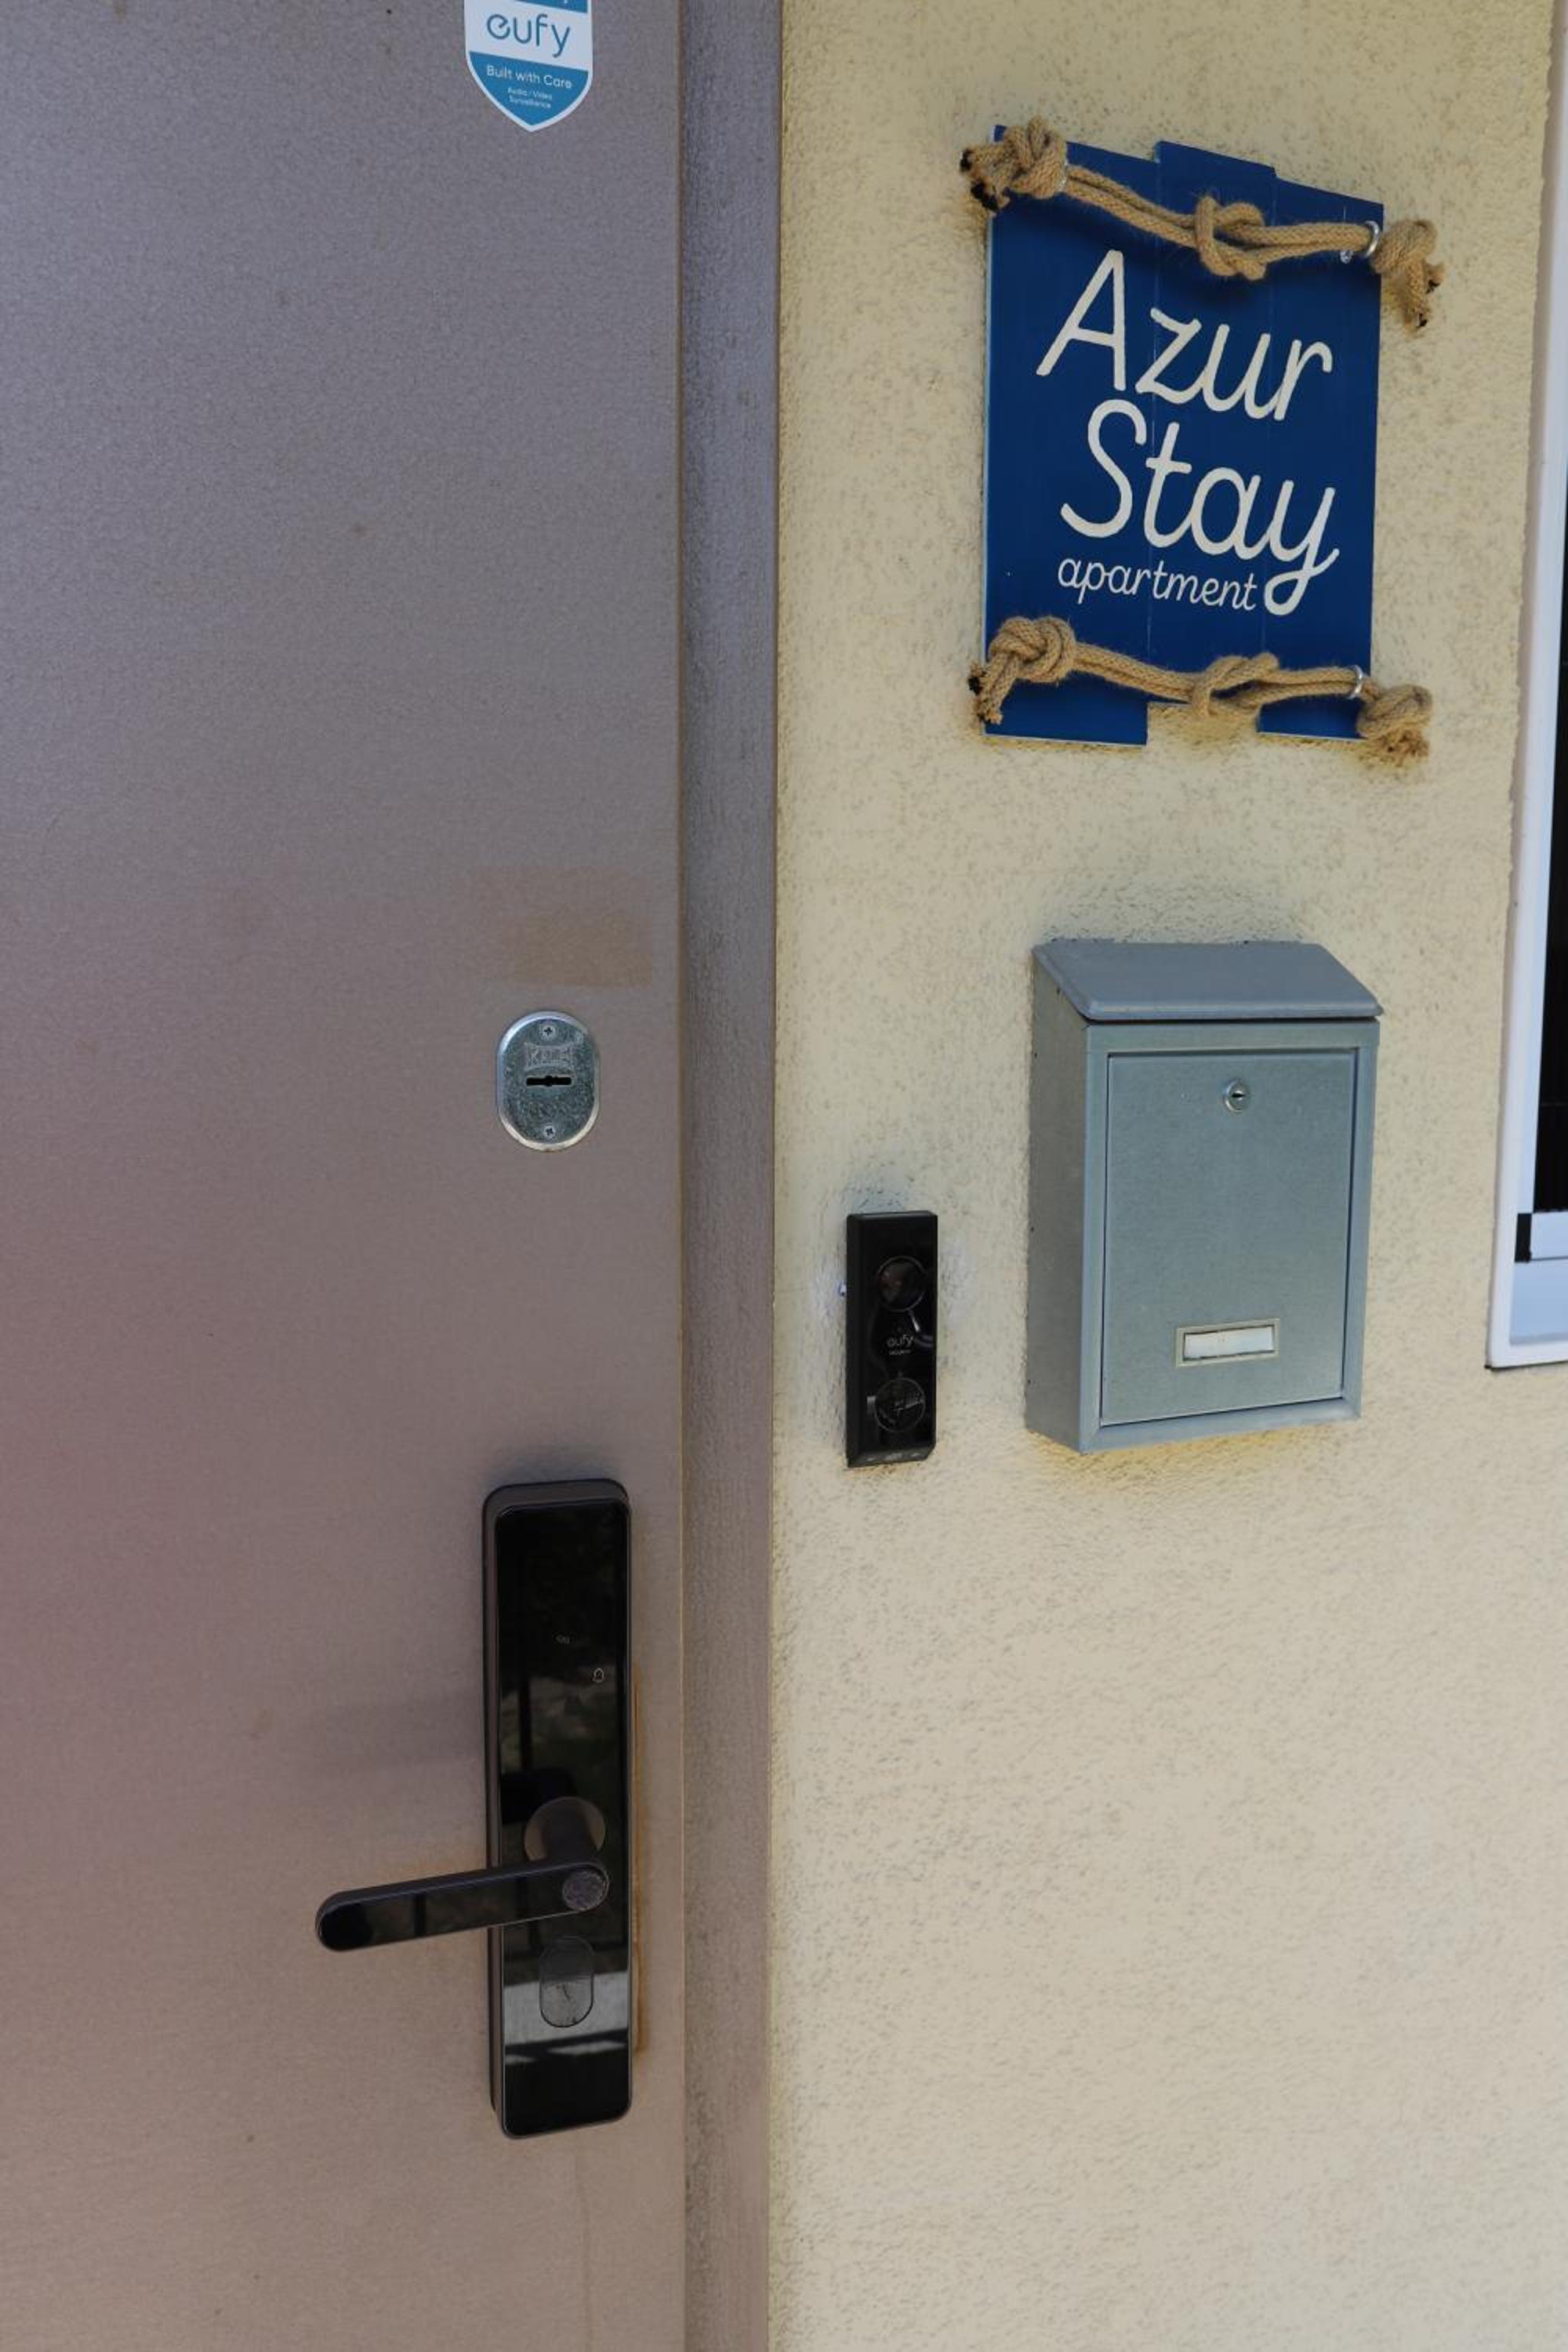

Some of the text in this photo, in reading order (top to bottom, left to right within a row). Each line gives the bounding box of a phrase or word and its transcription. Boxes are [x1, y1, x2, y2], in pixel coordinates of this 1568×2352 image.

[486, 13, 571, 58] eufy
[486, 64, 572, 89] Built with Care
[1036, 249, 1333, 421] Azur
[1060, 398, 1340, 616] Stay
[1057, 558, 1258, 612] apartment
